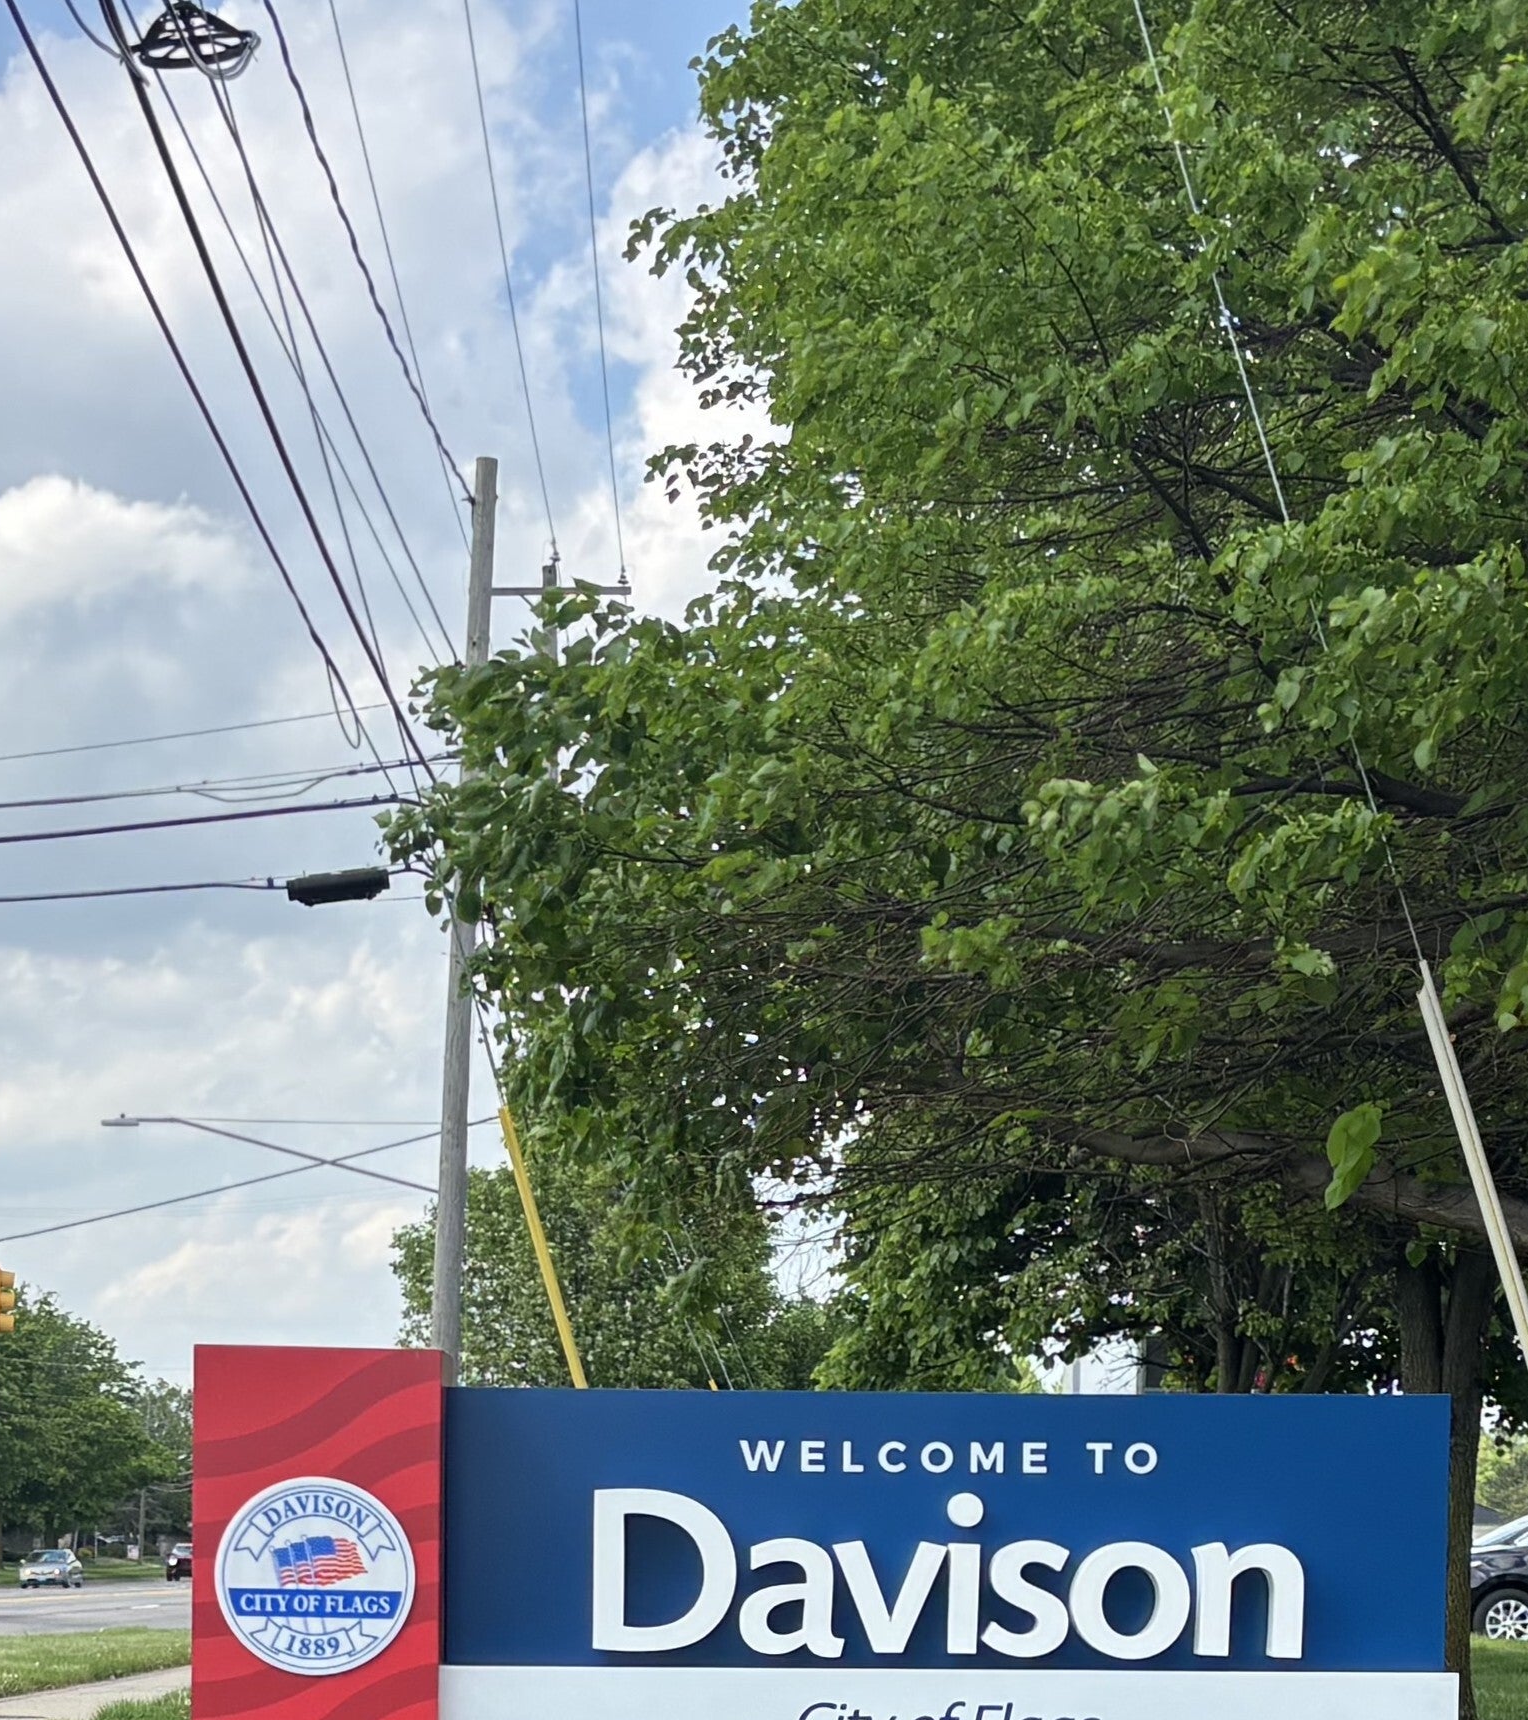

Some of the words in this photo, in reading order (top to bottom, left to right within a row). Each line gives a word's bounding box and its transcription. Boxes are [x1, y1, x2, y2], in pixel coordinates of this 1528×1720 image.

[739, 1440, 1048, 1474] WELCOME
[1086, 1442, 1159, 1475] TO
[262, 1494, 370, 1529] DAVISON
[591, 1487, 1305, 1661] Davison
[240, 1593, 290, 1612] CITY
[293, 1594, 321, 1613] OF
[325, 1595, 391, 1615] FLAGS
[285, 1634, 340, 1656] 1889
